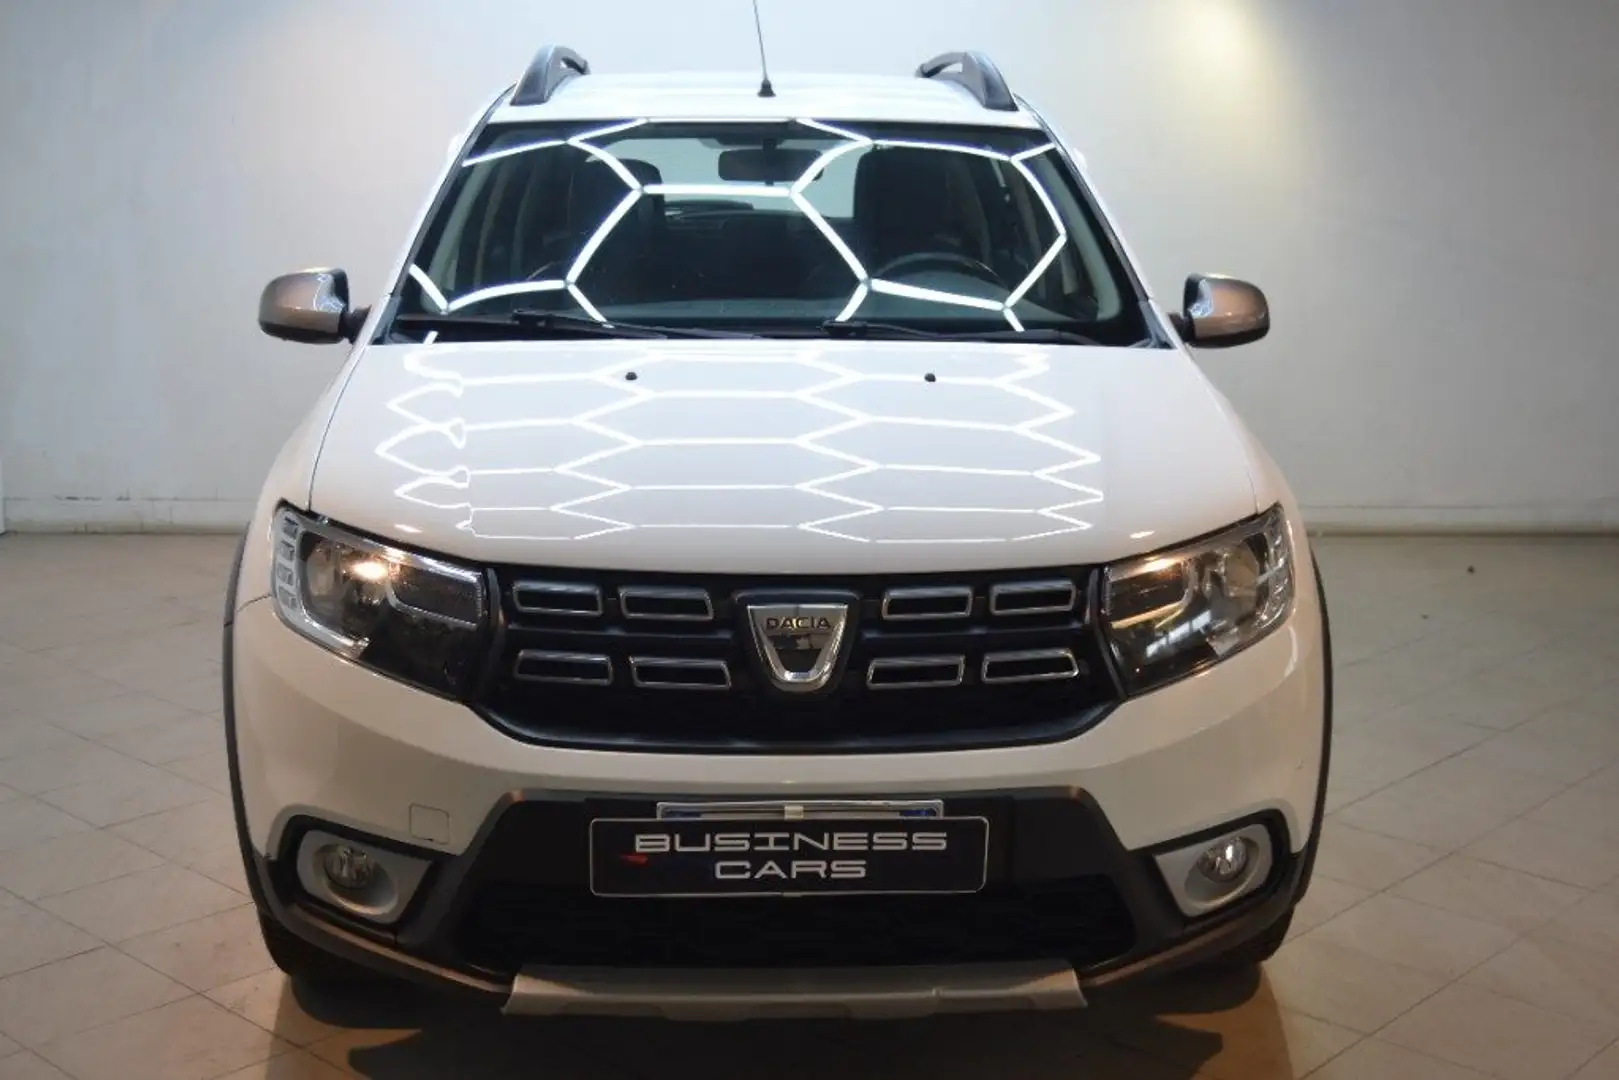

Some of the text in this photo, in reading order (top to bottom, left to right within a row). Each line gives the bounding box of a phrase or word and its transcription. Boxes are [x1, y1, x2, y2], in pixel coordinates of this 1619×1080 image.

[766, 617, 831, 629] DACIA
[634, 832, 947, 853] BUSINESS
[714, 859, 867, 880] CARS
